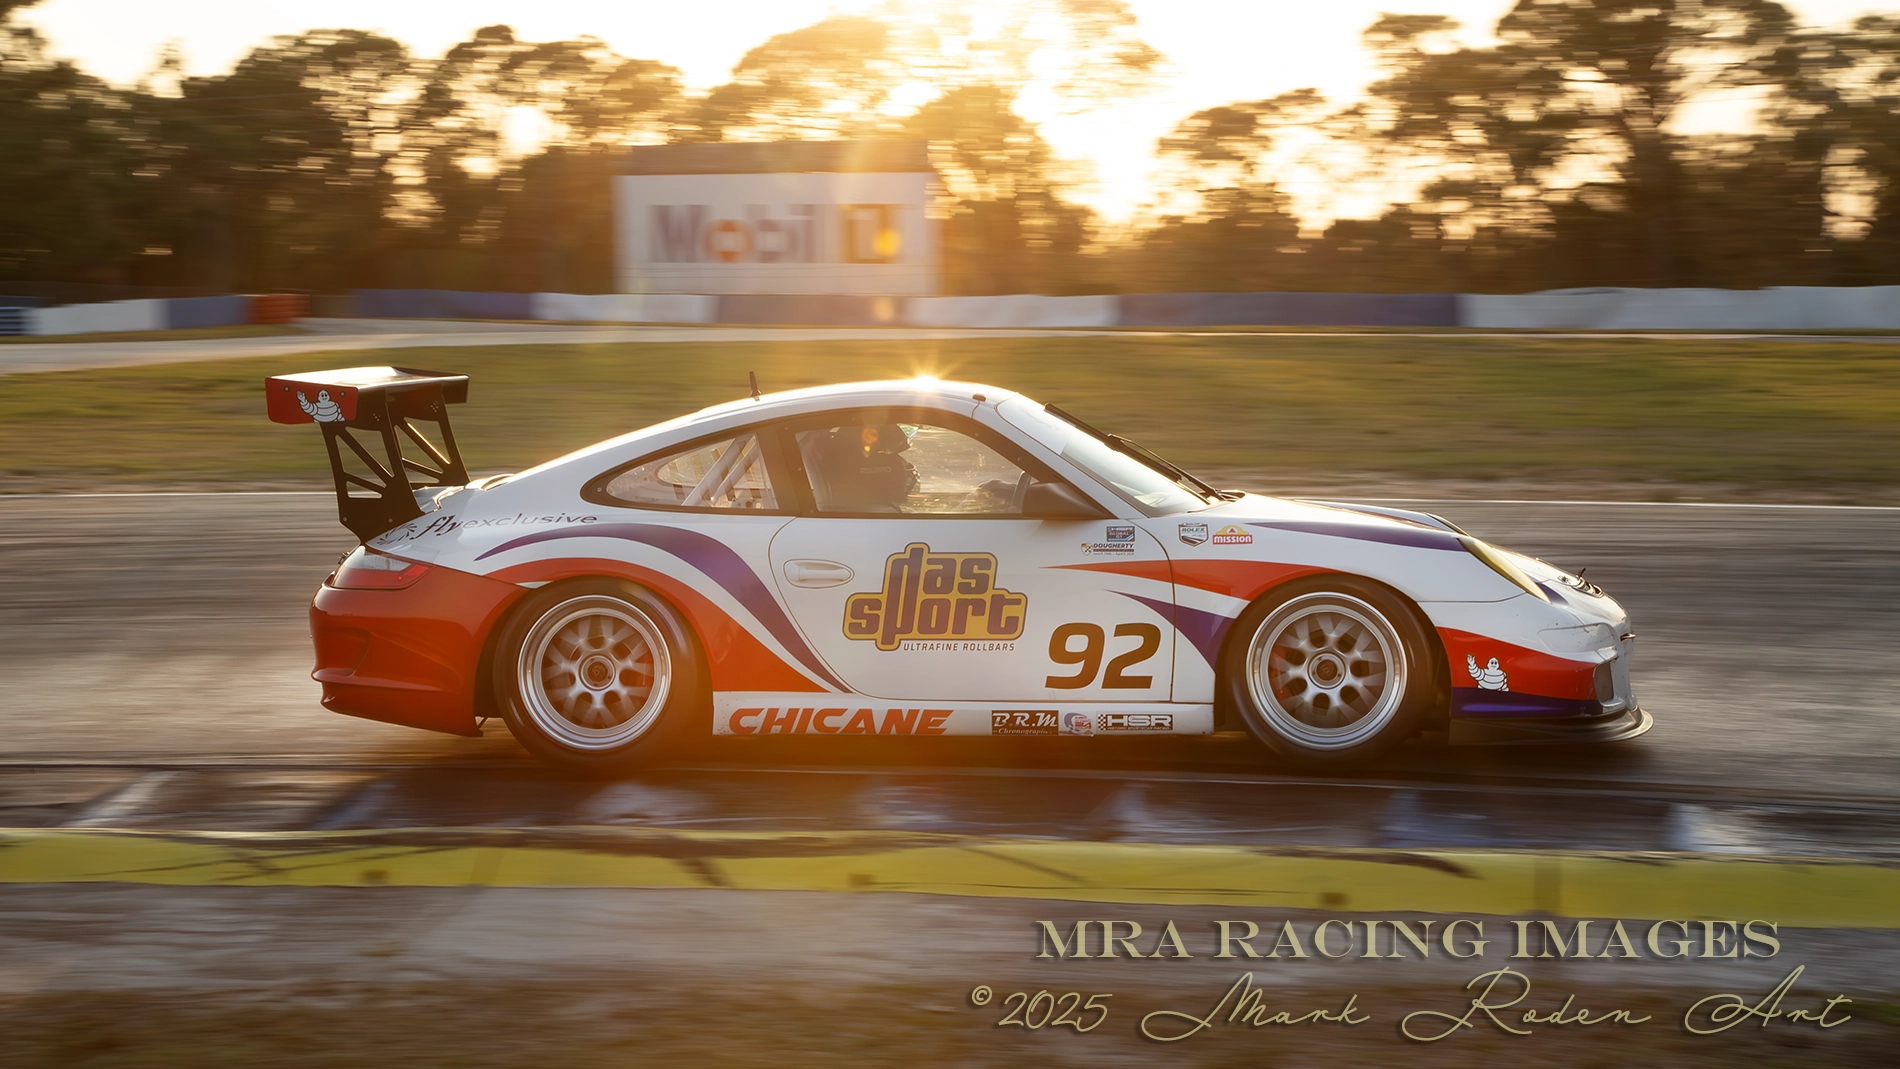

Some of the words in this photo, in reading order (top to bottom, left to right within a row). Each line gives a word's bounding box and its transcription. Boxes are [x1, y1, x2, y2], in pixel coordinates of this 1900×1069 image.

[646, 204, 815, 263] Mobil
[410, 508, 599, 540] flyexclusive
[885, 548, 992, 595] das
[848, 594, 1022, 646] sport
[903, 642, 959, 652] ULTRAFINE
[962, 642, 1016, 652] ROLLBARS
[1044, 622, 1162, 690] 92
[729, 708, 954, 735] CHICANE
[992, 712, 1058, 727] B.R.M
[1107, 715, 1172, 727] HSR
